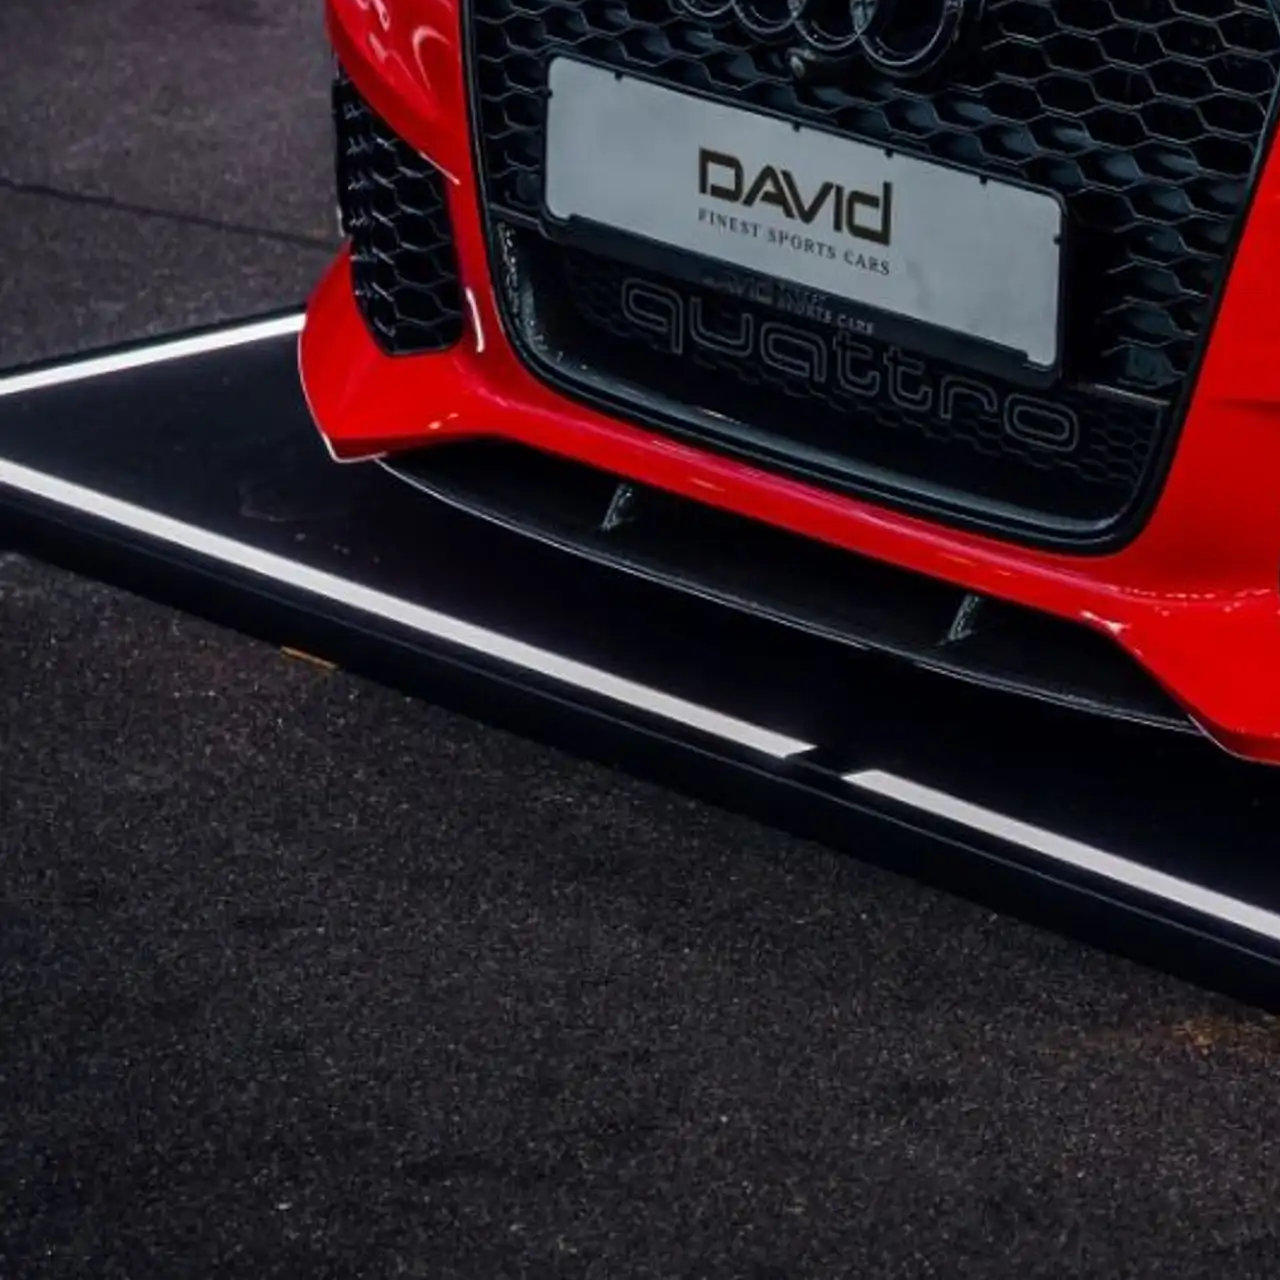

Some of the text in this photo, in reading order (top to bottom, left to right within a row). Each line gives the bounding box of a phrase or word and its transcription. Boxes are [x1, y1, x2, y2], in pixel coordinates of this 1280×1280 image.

[698, 207, 890, 276] FINEST SPORTS CARS
[620, 276, 1080, 453] quattro
